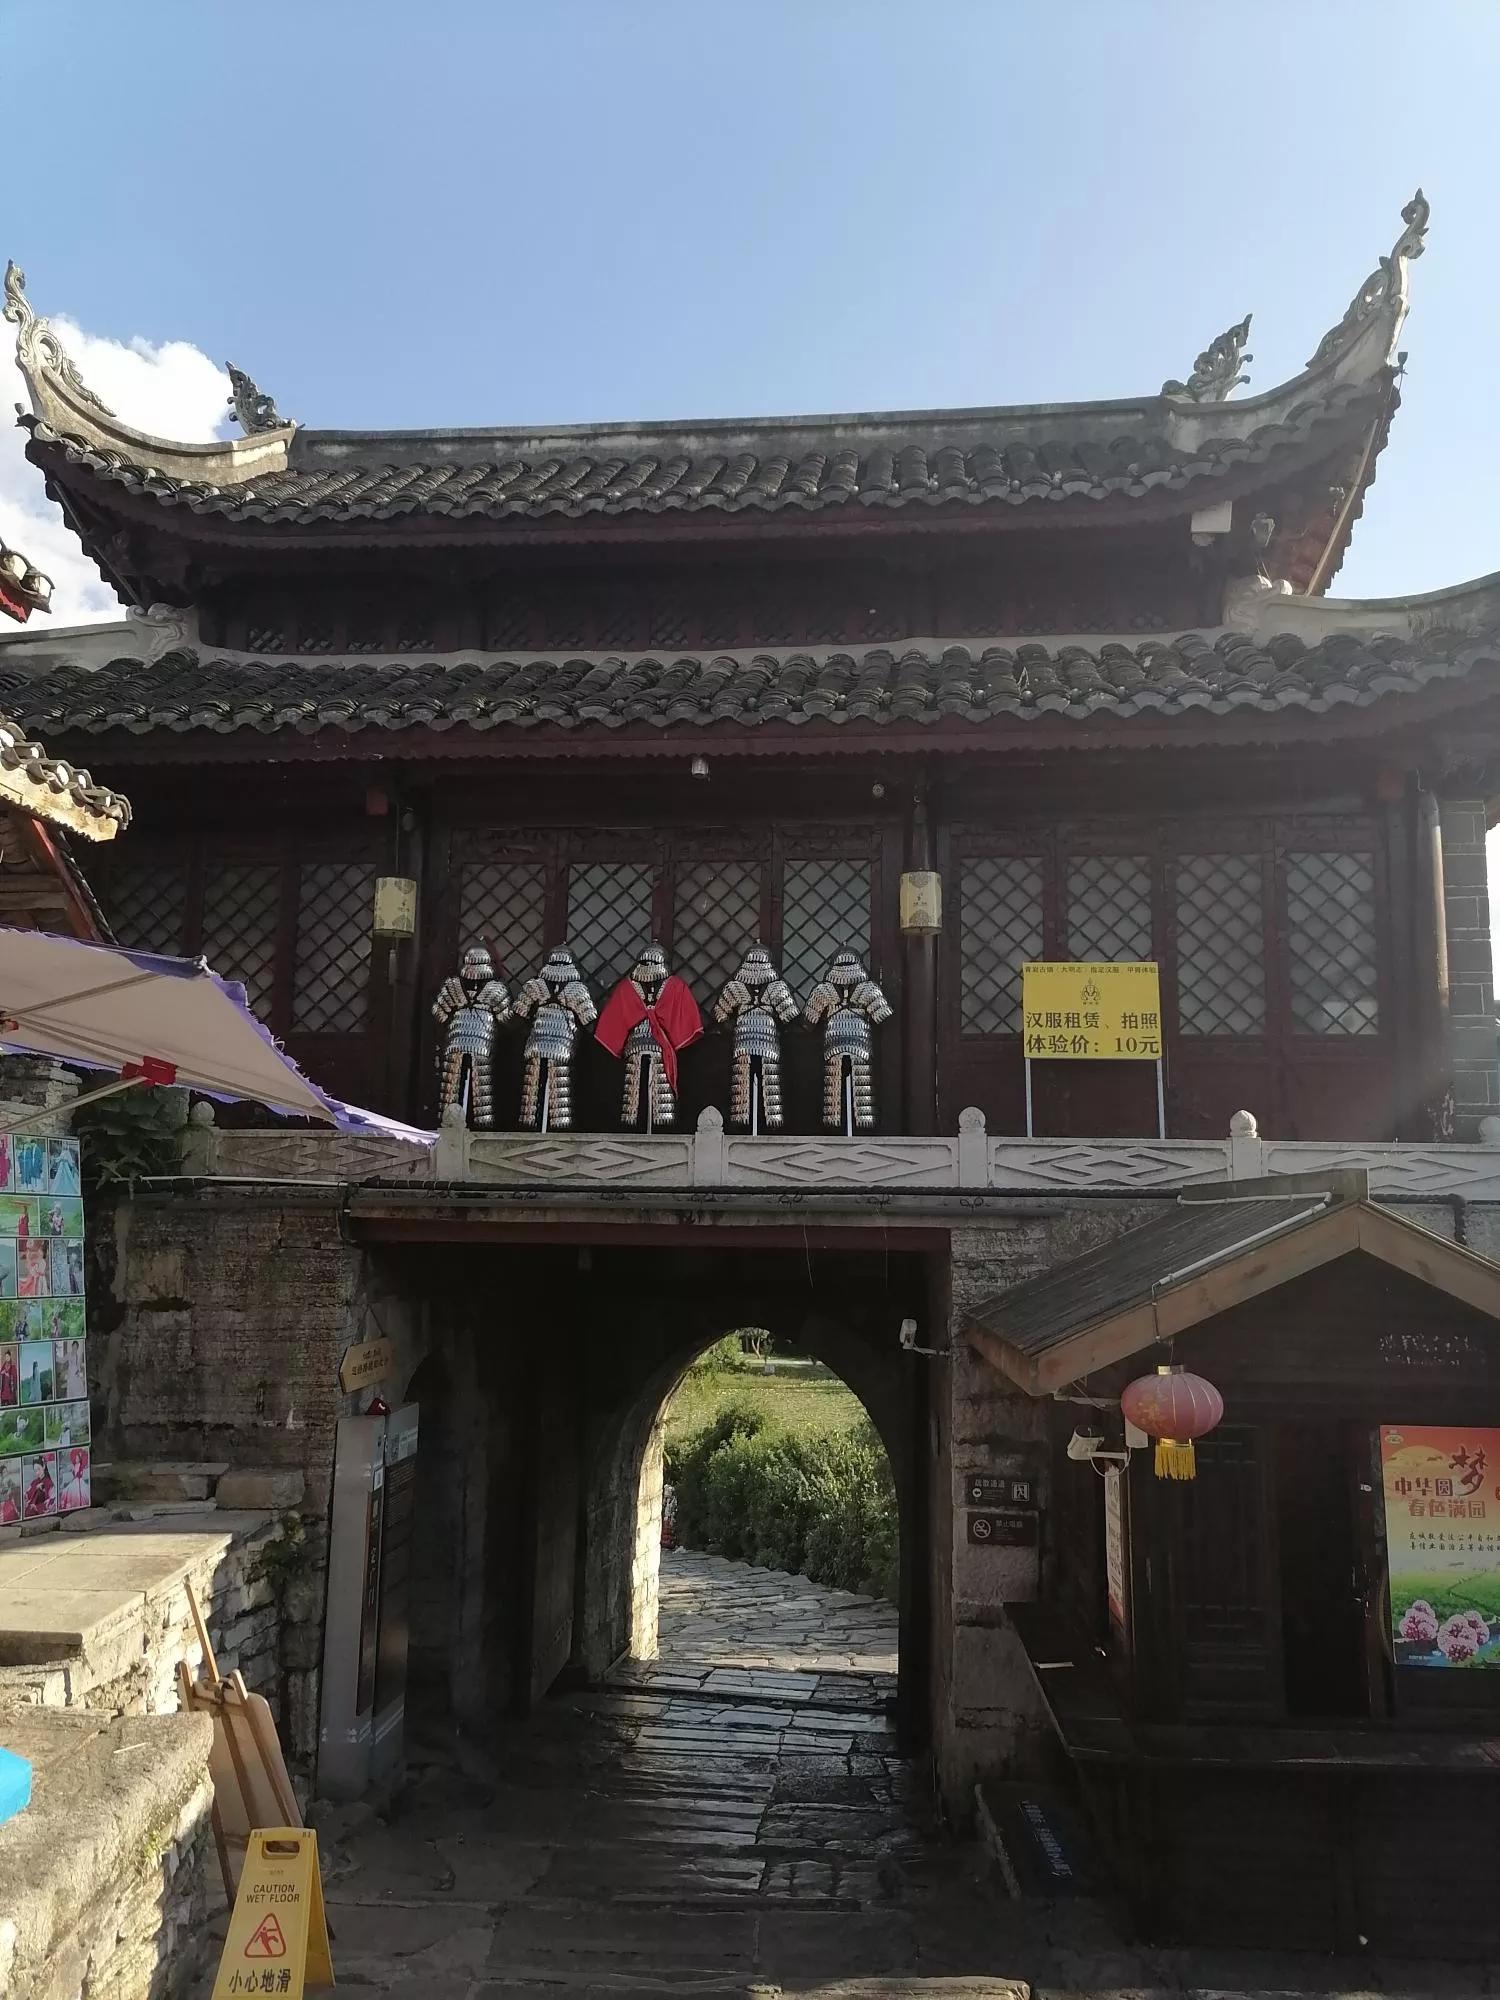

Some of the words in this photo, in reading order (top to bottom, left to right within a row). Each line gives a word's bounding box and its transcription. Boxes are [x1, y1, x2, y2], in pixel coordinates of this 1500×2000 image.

[1408, 1498, 1486, 1518] 春色满园
[253, 1884, 295, 1894] CAUTION
[246, 1894, 266, 1903] WET
[269, 1893, 300, 1903] FLOOR
[229, 1968, 291, 1993] 小心地滑
